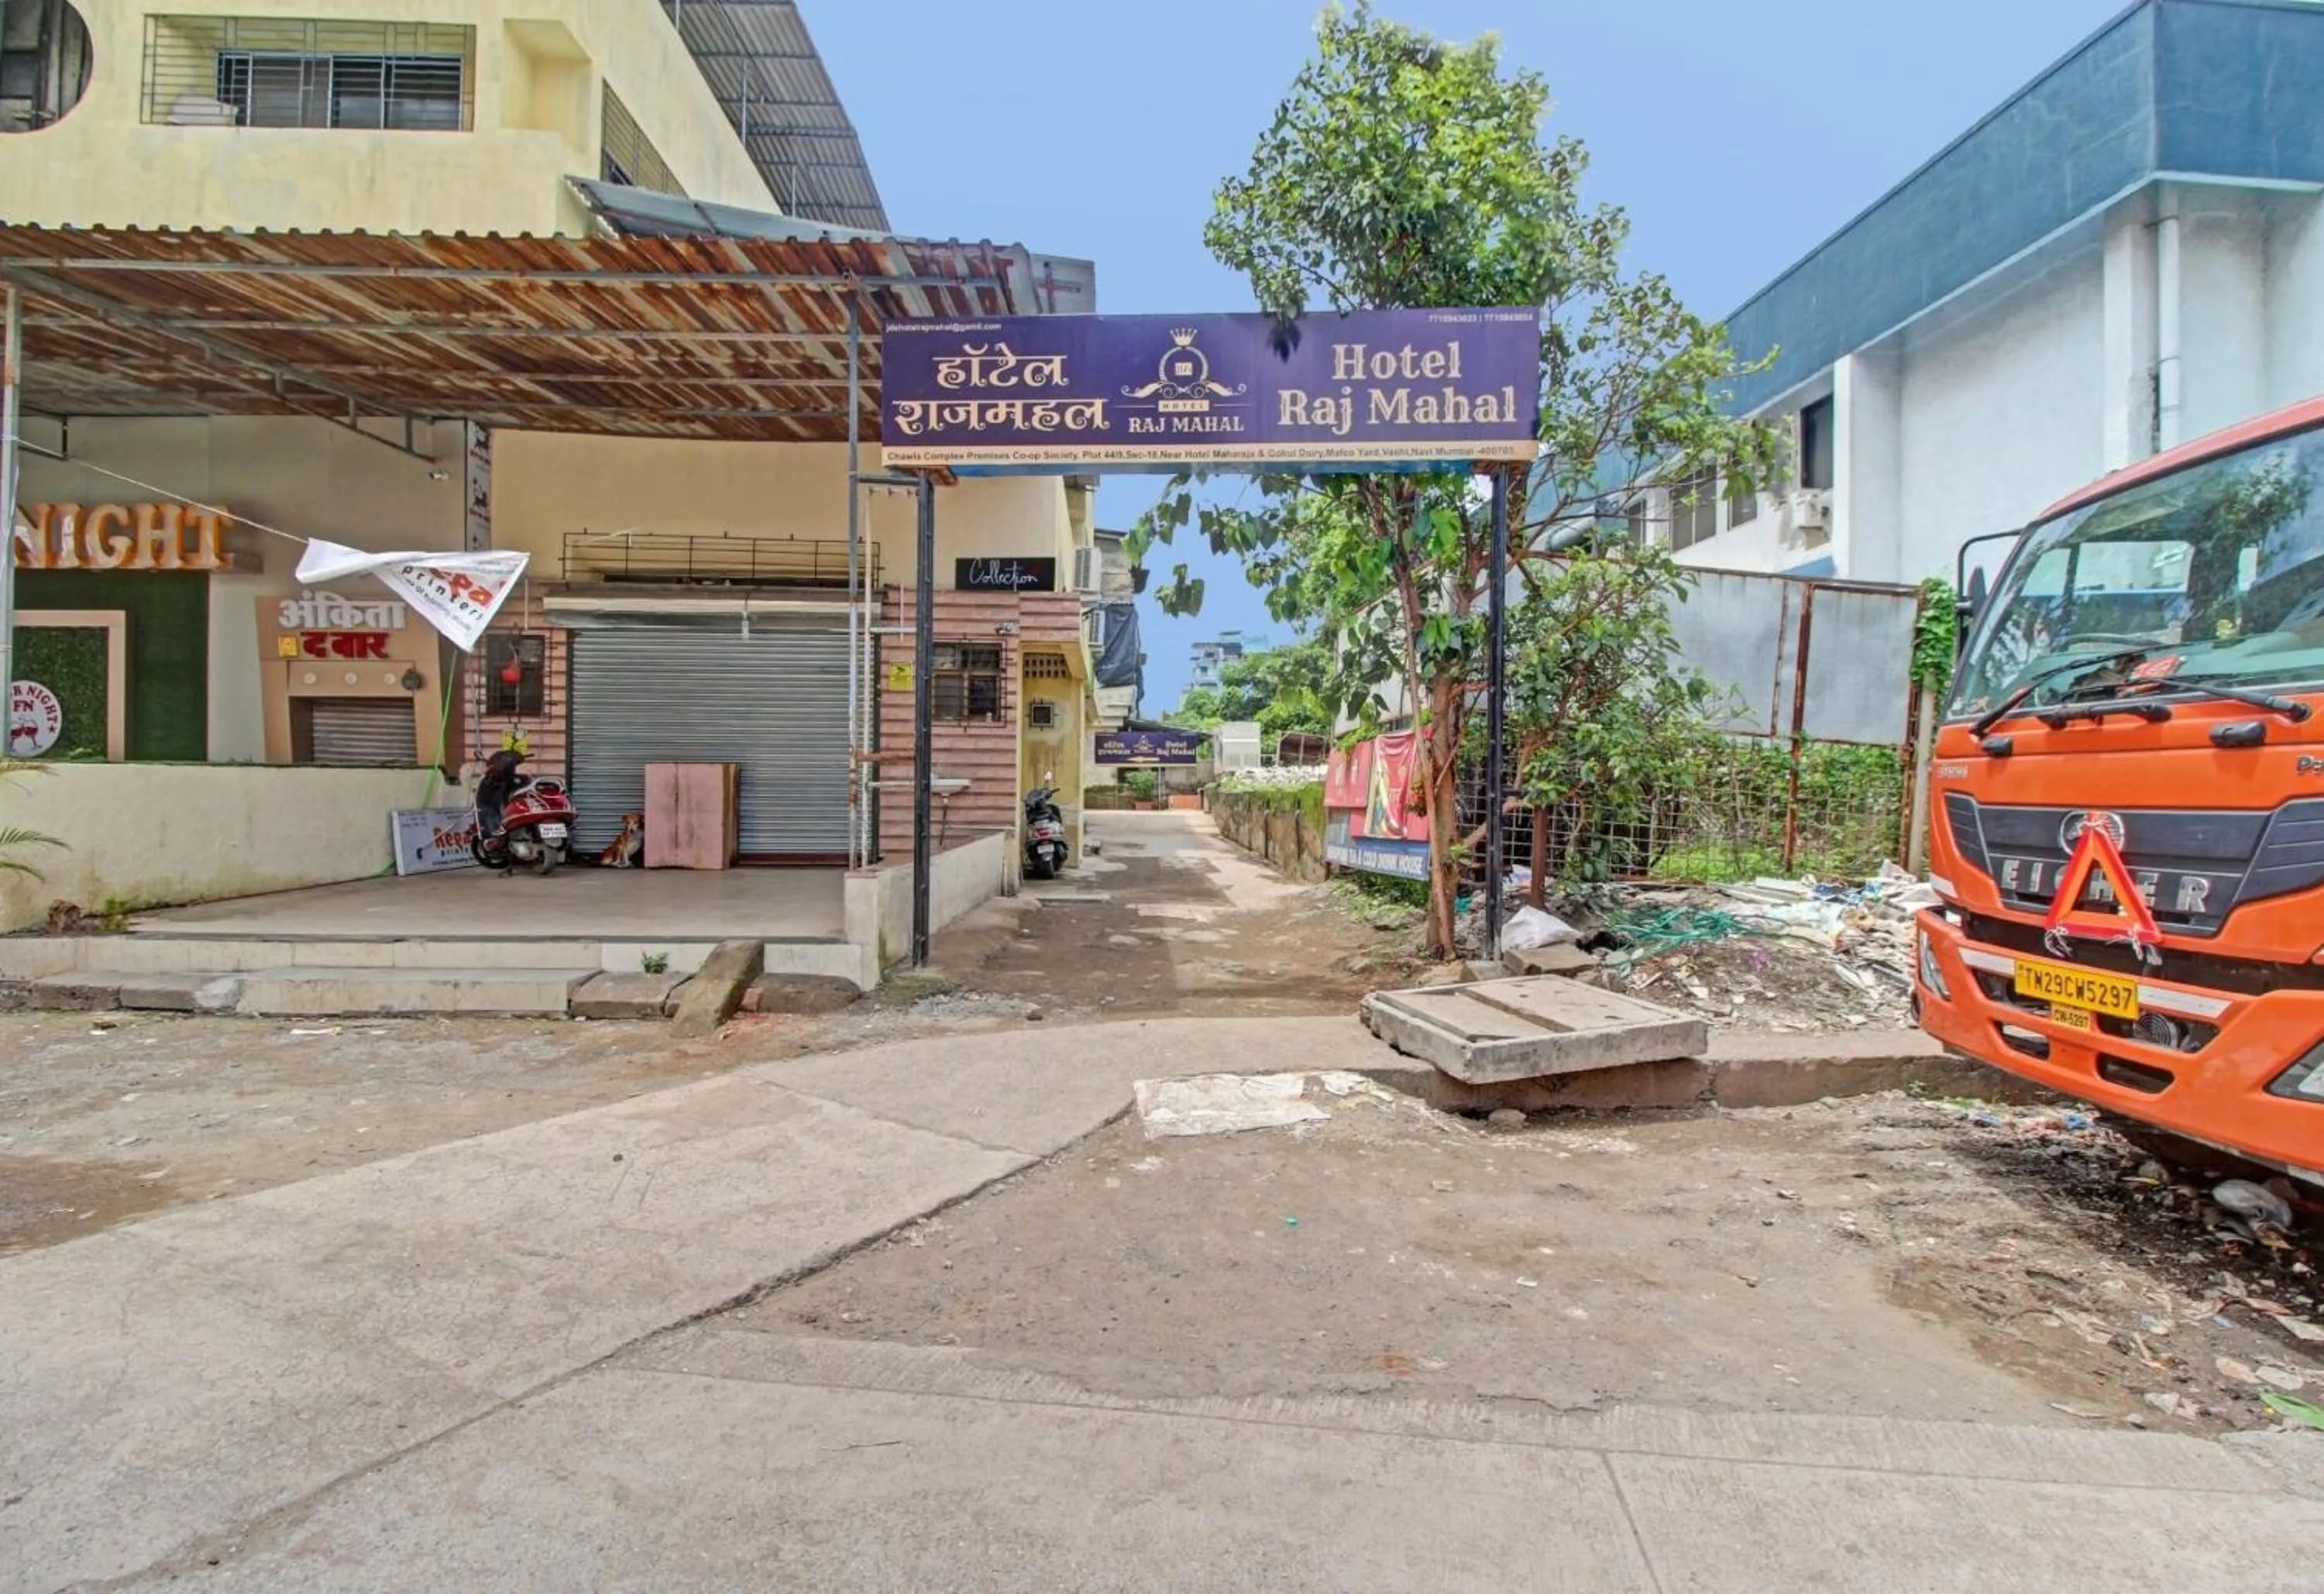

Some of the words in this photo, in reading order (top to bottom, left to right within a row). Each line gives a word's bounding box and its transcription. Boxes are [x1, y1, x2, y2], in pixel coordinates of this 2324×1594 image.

[932, 342, 1070, 389] हॉटेल
[1332, 341, 1463, 380] Hotel
[892, 397, 1111, 435] राजमहल
[1128, 417, 1166, 433] RAJ
[1172, 416, 1245, 433] MAHAL
[1277, 386, 1353, 435] Raj
[1367, 385, 1518, 425] Mahal
[1012, 451, 1042, 462] Co-op
[1185, 449, 1212, 459] Hotel
[1258, 448, 1264, 458] &
[14, 501, 234, 569] NIGHT
[969, 558, 1039, 592] Collection
[278, 589, 406, 629] अंकिता
[12, 699, 34, 713] FN
[26, 684, 59, 723] NIGHT
